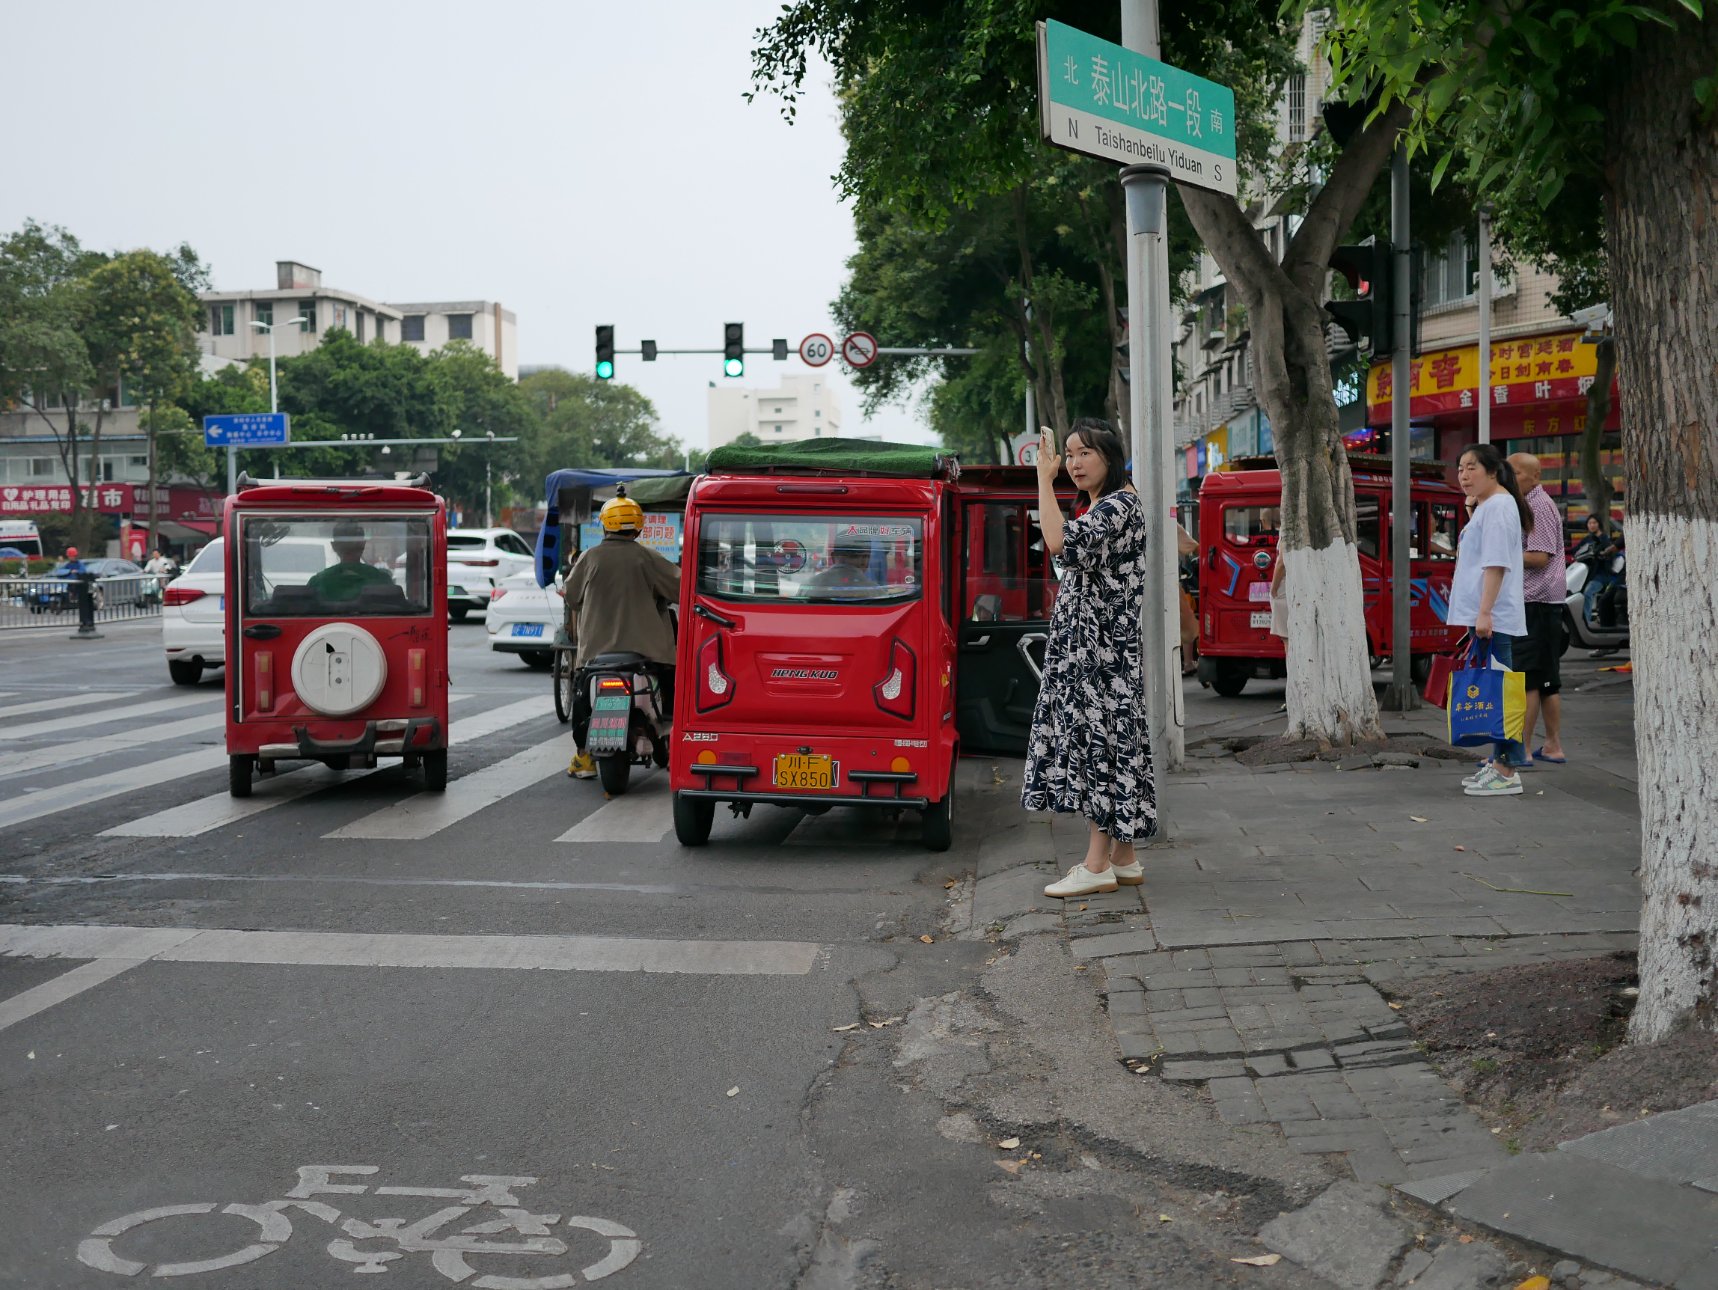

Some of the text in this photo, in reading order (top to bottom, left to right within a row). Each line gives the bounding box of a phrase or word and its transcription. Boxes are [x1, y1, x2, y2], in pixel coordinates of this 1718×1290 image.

[1063, 54, 1223, 138] 北 泰山北路一段 南
[1068, 117, 1222, 182] N Taishanbeilu Yiduan S
[807, 343, 826, 358] 60
[809, 670, 838, 680] KUO
[780, 771, 828, 788] SX850
